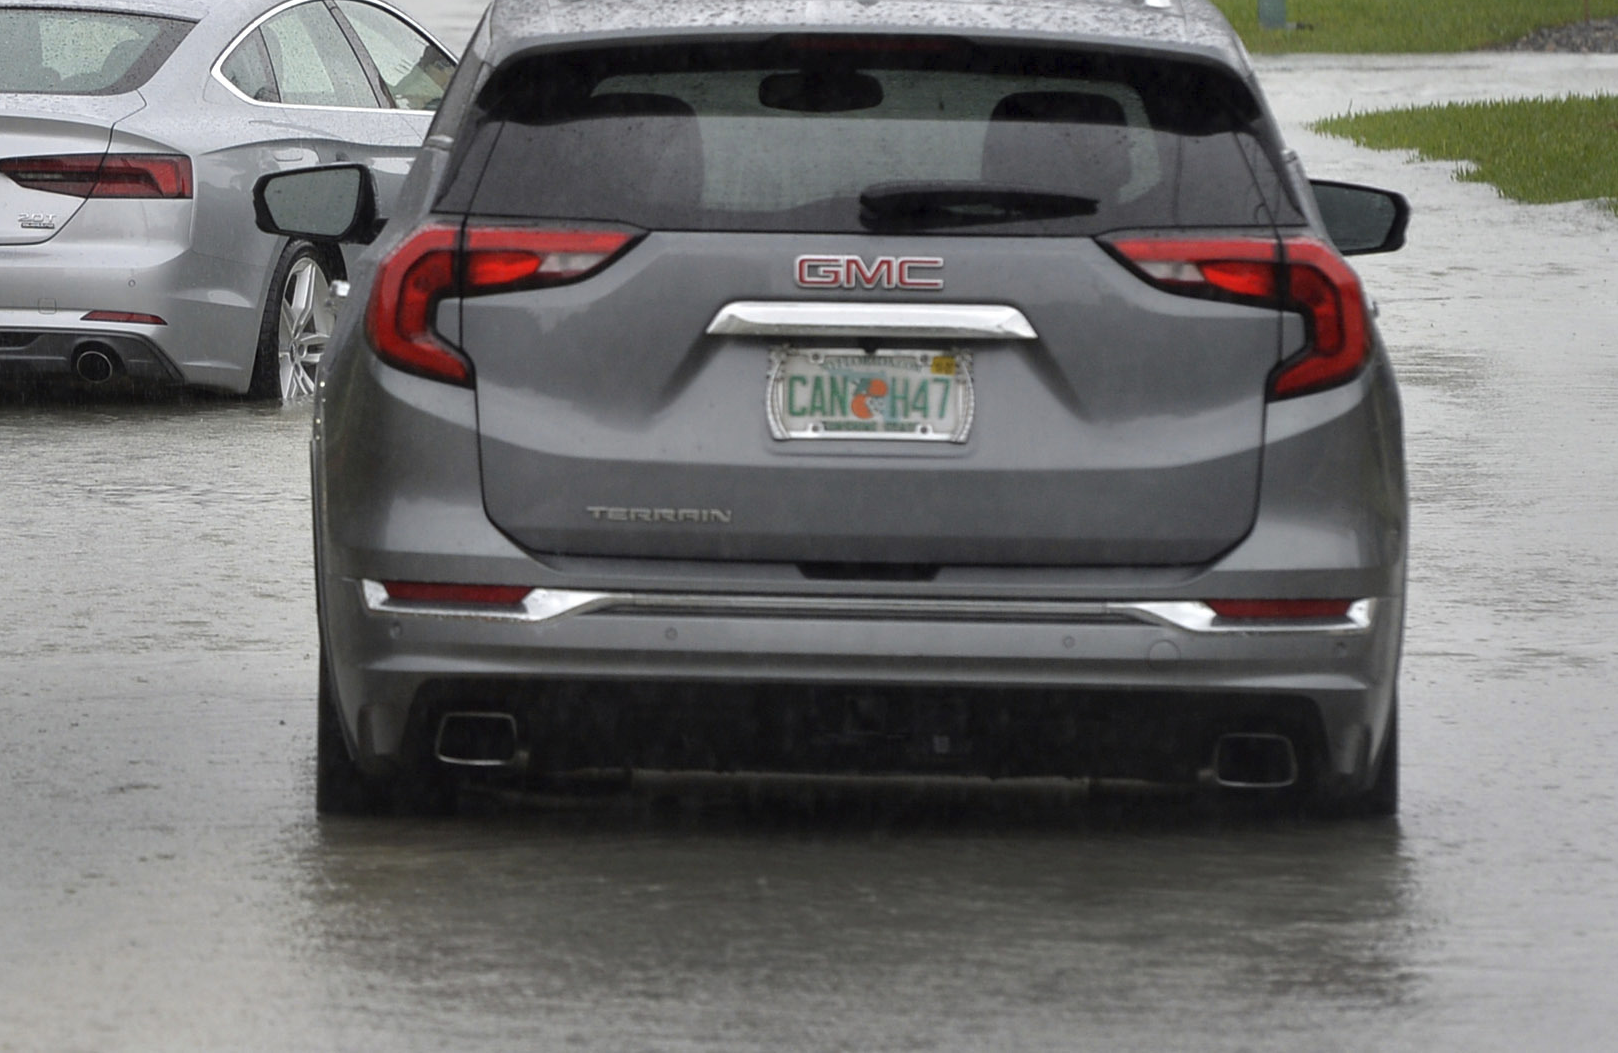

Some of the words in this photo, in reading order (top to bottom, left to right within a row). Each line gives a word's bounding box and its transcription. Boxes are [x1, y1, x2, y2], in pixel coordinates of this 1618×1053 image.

[794, 254, 944, 289] GMC
[788, 375, 848, 417] CAN
[890, 376, 951, 419] H47
[586, 505, 732, 523] TERRAIN
